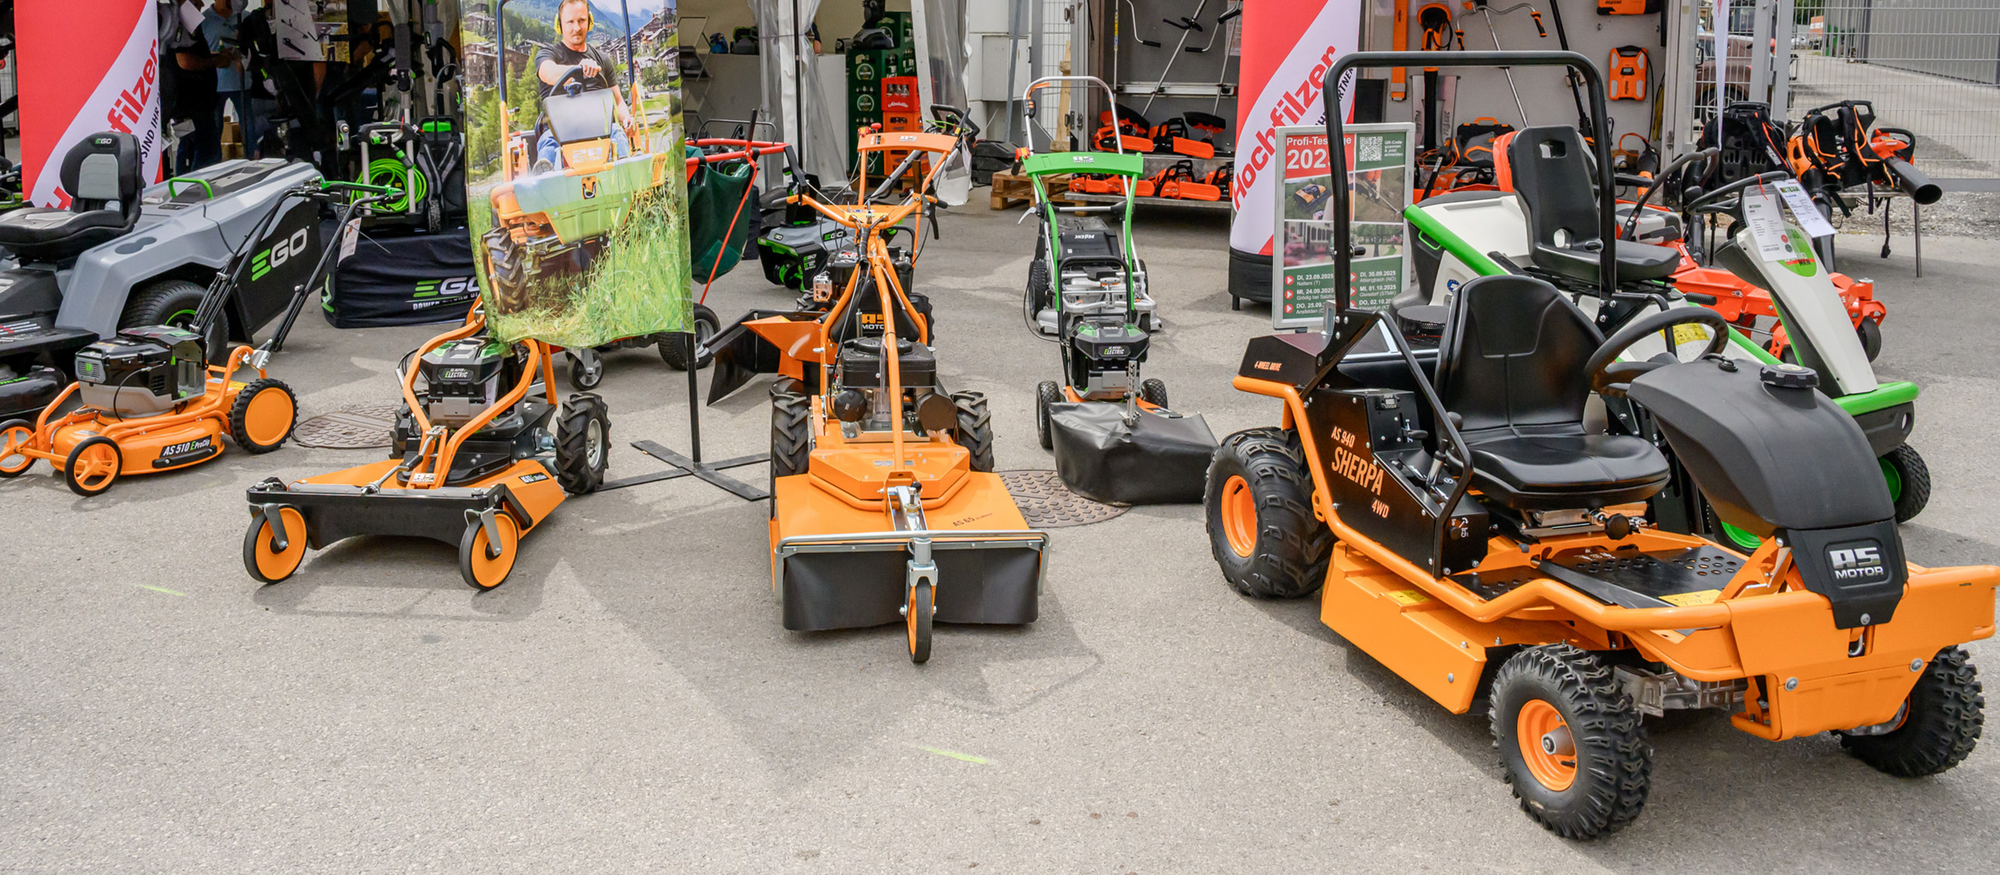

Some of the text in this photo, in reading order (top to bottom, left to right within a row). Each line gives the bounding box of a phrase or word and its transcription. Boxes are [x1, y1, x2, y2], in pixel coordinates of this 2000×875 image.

[1234, 45, 1336, 211] Hochfilzer
[1286, 136, 1352, 147] Profi-Tese
[1286, 148, 1331, 170] 202
[823, 230, 845, 242] EGO
[252, 228, 307, 282] EGO
[444, 371, 469, 379] ELECTRIC
[1331, 426, 1356, 448] AS 940
[162, 445, 176, 457] AS
[175, 442, 190, 454] 510
[1331, 446, 1385, 496] SHERPA
[1371, 499, 1390, 519] 4WD
[1829, 546, 1881, 569] AS
[1834, 566, 1885, 580] MOTOR
